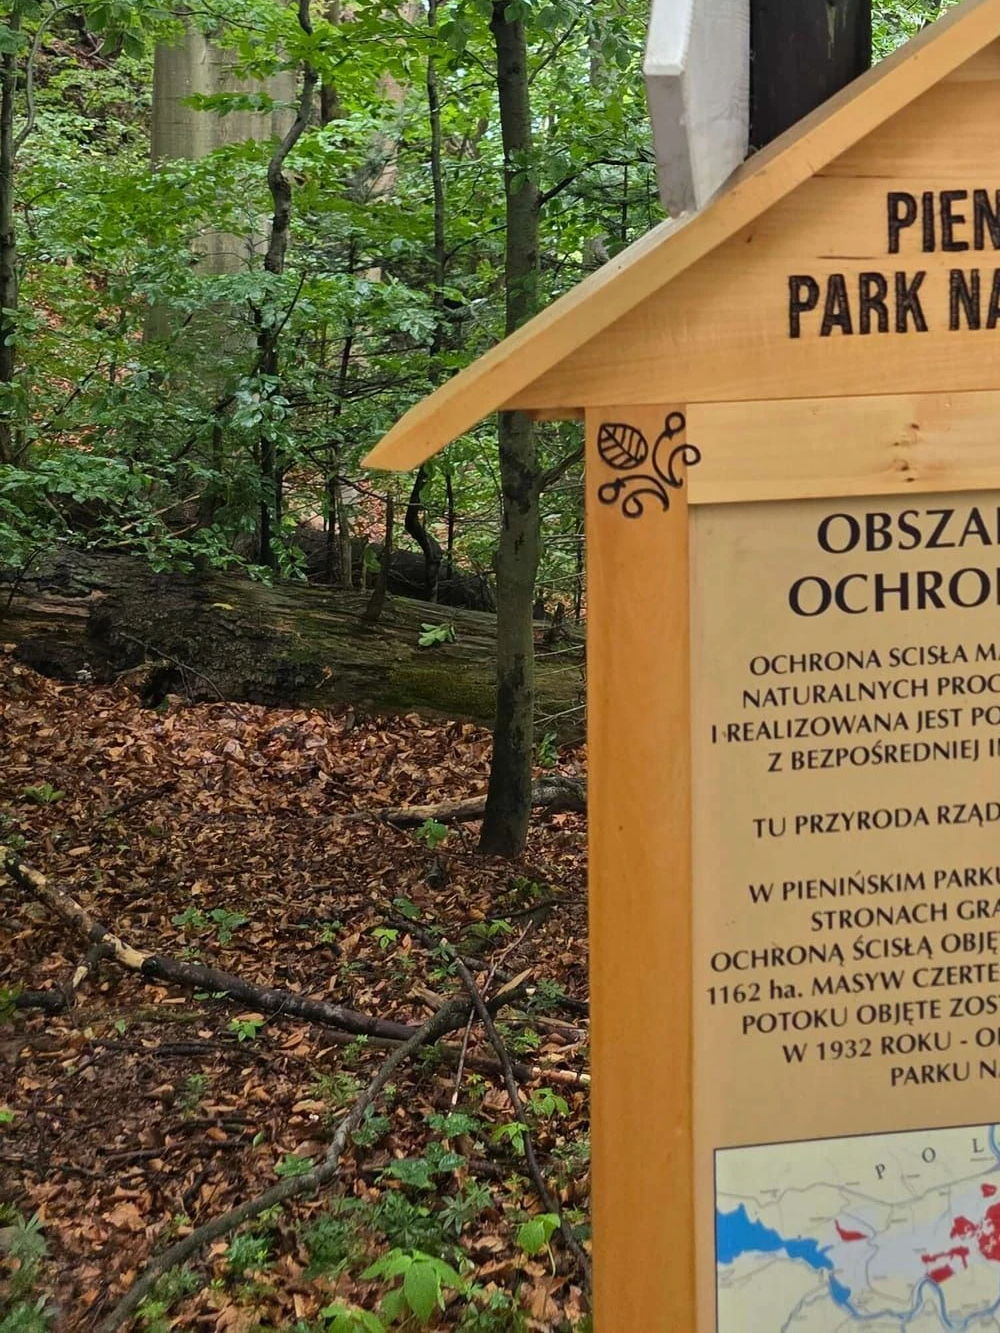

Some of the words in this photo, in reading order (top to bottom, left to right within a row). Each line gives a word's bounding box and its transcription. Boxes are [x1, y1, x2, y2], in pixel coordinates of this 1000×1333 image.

[787, 270, 929, 339] PARK
[749, 649, 882, 676] OCHRONA
[888, 644, 969, 668] SCISŁA
[742, 677, 929, 709] NATURALNYCH
[727, 712, 910, 743] REALIZOWANA
[916, 708, 964, 733] JEST
[767, 751, 783, 772] Z
[791, 739, 980, 771] BEZPOŚREDNIEJ
[753, 817, 787, 838] TU
[795, 807, 930, 835] PRZYRODA
[749, 883, 774, 904] W
[782, 870, 926, 901] PIENIŃSKIM
[811, 902, 948, 932] STRONACH
[710, 942, 845, 972] OCHRONĄ
[852, 934, 934, 961] ŚCISŁĄ
[707, 983, 761, 1005] 1162
[769, 979, 803, 1000] ha.
[811, 970, 905, 997] MASYW
[742, 1006, 848, 1035] POTOKU
[856, 999, 941, 1026] OBJĘTE
[782, 1043, 808, 1064] W
[817, 1038, 872, 1061] 1932
[881, 1031, 951, 1055] ROKU
[891, 1062, 971, 1086] PARKU
